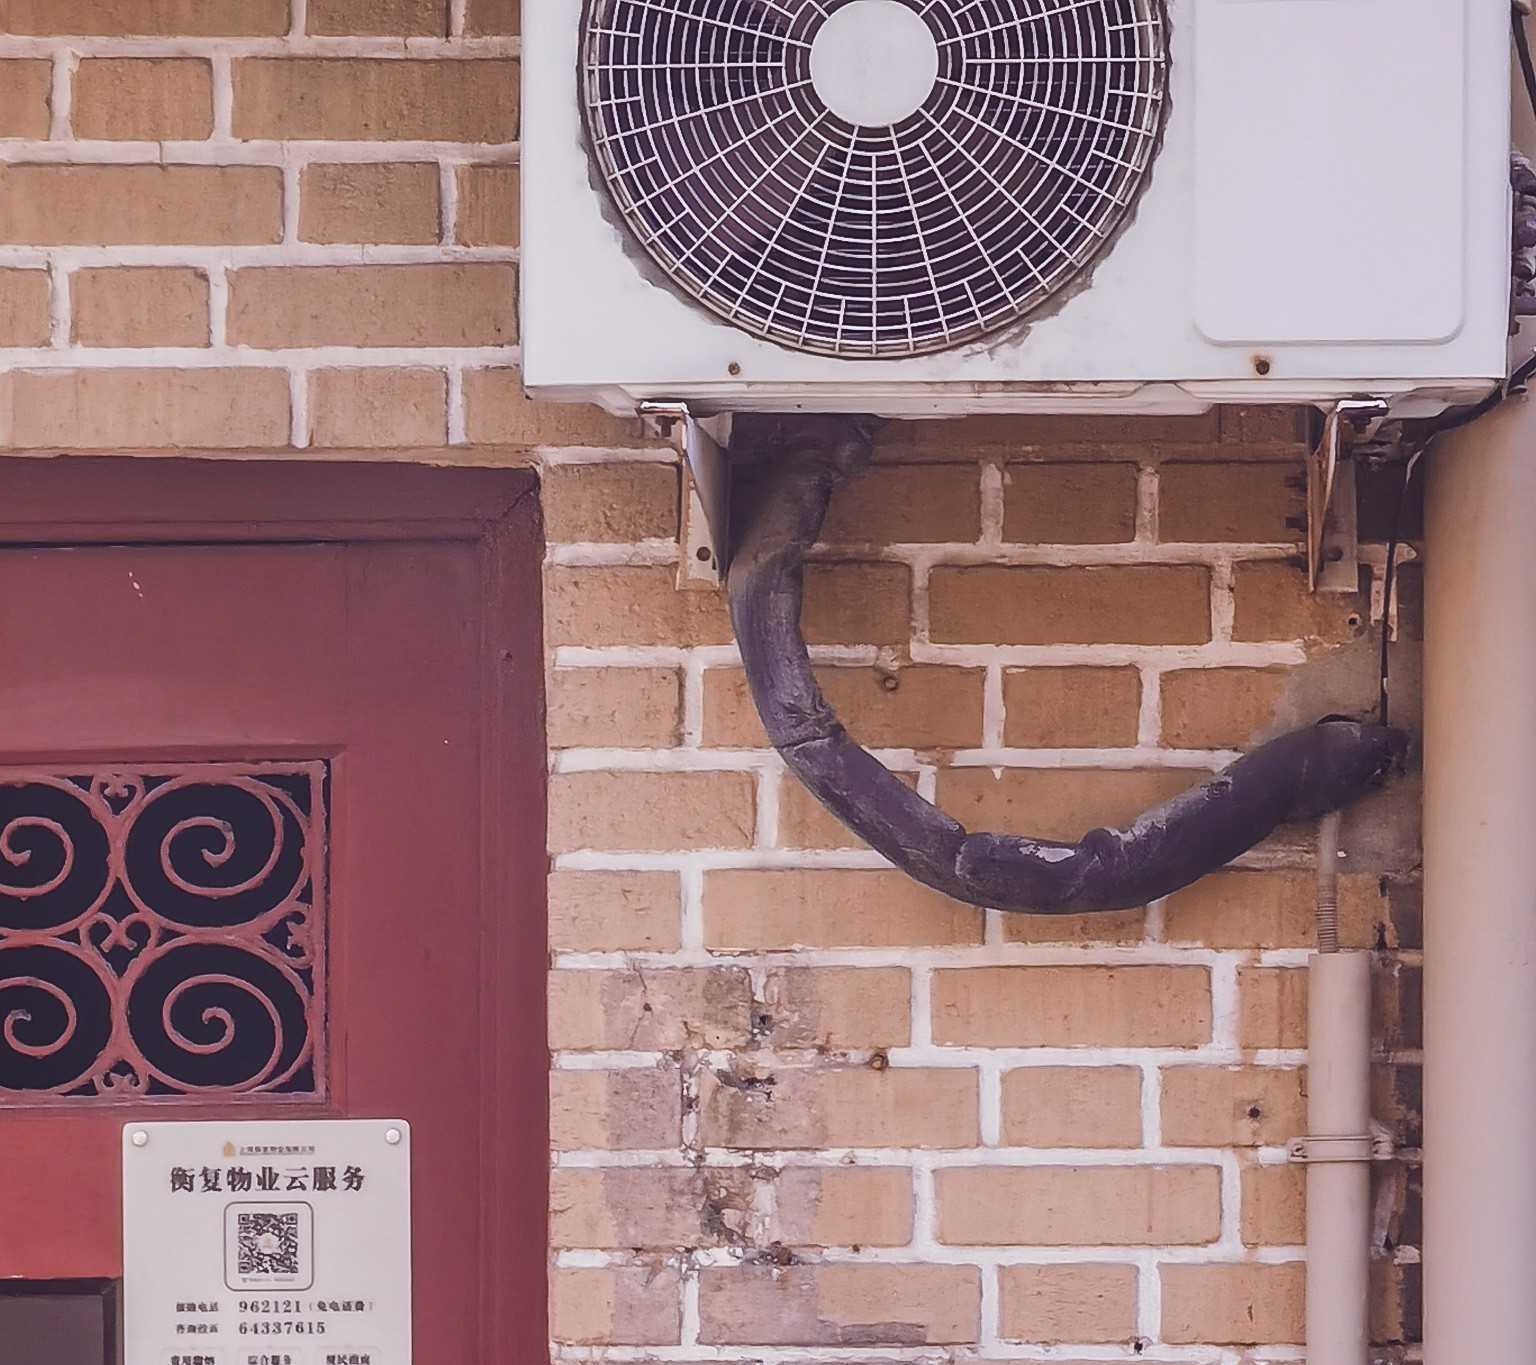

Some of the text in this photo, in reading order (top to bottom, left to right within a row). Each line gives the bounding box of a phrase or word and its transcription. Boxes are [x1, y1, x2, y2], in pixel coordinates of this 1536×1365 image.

[170, 1165, 365, 1192] 衡复物业云服务
[239, 1300, 302, 1314] 962121
[239, 1321, 326, 1336] 64337615
